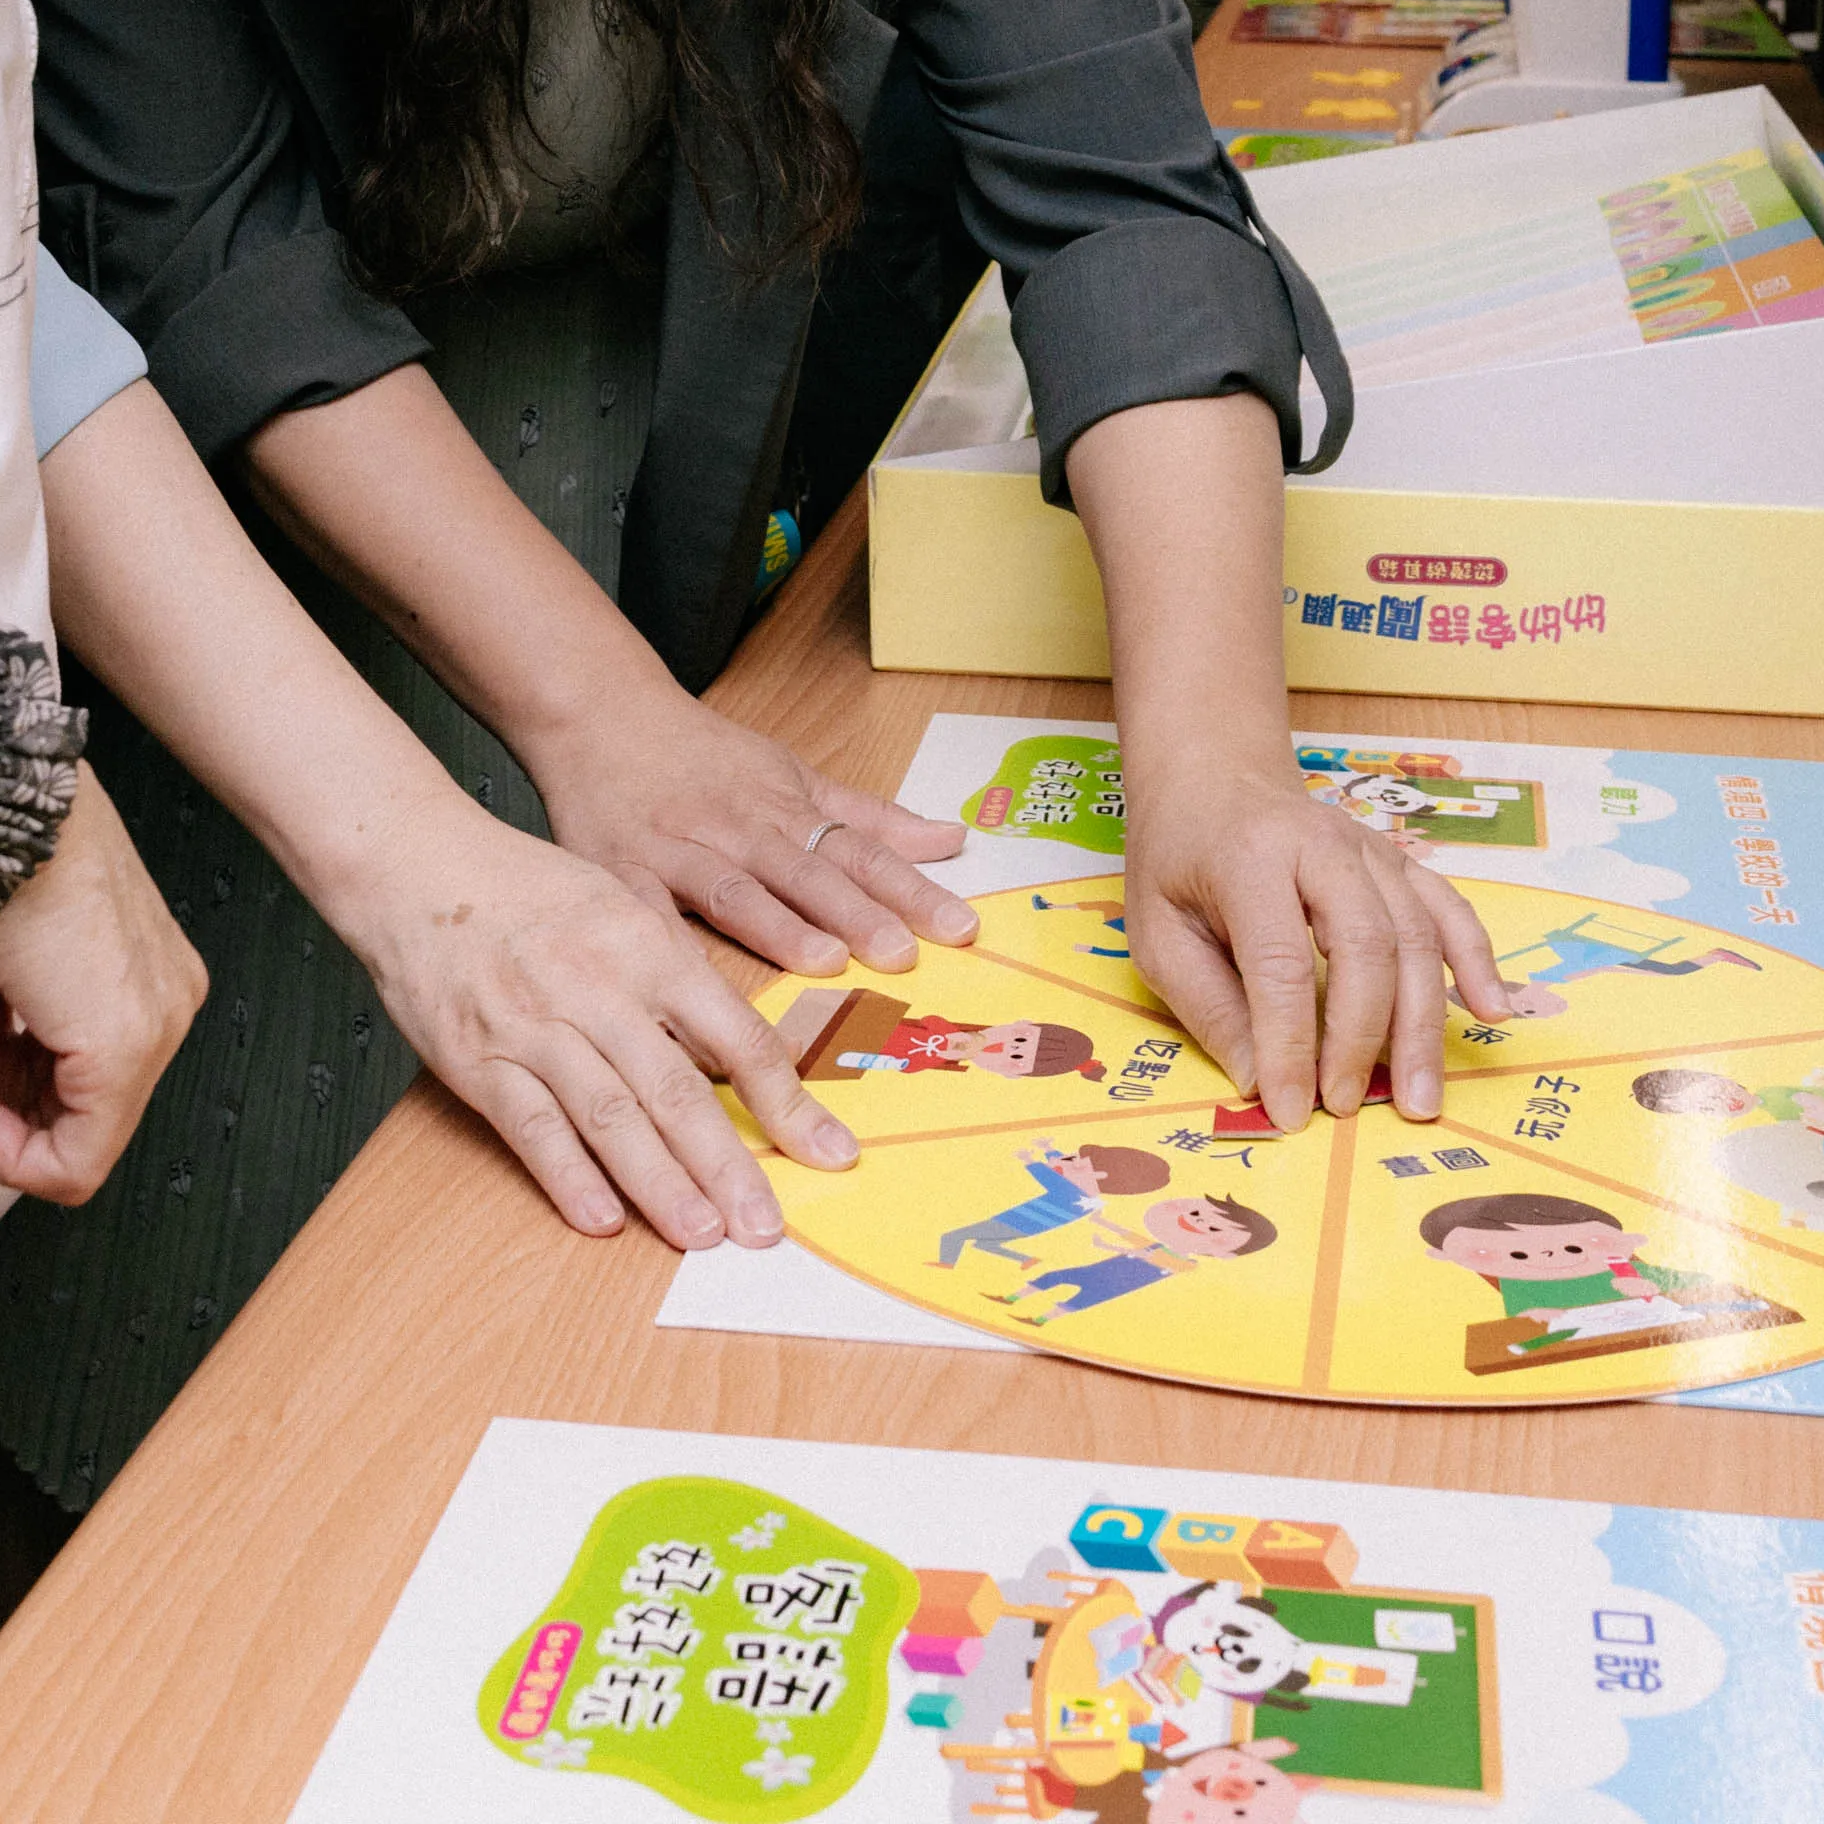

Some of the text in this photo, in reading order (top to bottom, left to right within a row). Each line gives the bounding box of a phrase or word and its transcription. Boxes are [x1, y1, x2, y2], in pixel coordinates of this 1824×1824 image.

[1021, 759, 1084, 824] 好好玩
[1600, 786, 1639, 816] 聽力
[1108, 1038, 1183, 1102] 吃點心
[1514, 1073, 1581, 1142] 玩沙子
[1157, 1126, 1255, 1169] 推人
[1085, 1509, 1324, 1550] A B C
[581, 1544, 716, 1728] 好好玩
[717, 1562, 866, 1716] 客語
[1592, 1609, 1664, 1694] 口說
